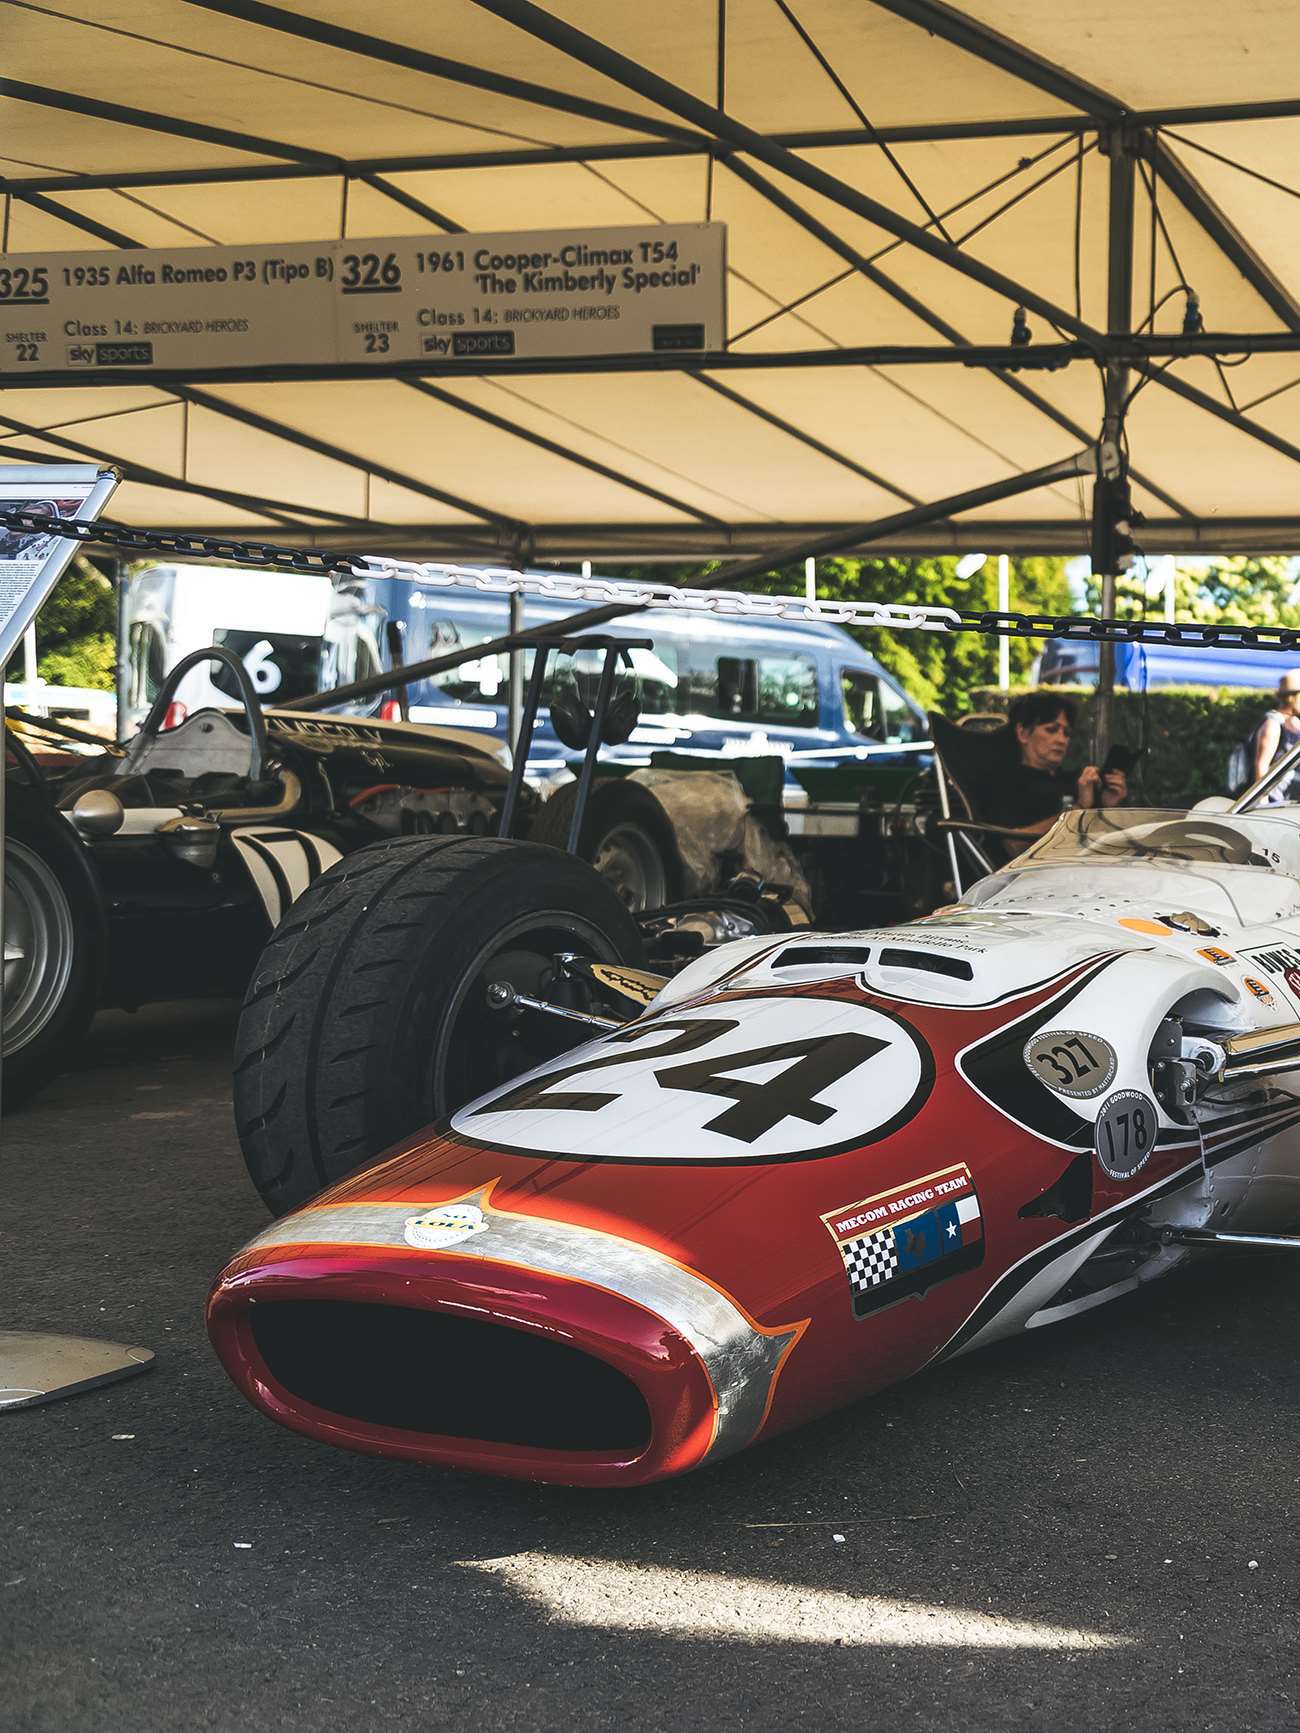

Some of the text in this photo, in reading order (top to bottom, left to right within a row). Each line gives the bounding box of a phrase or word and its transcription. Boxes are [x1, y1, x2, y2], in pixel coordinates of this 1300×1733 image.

[62, 256, 334, 287] 1935 Alfa Romeo P3 (Tipo B)
[341, 252, 401, 287] 326
[415, 241, 679, 275] 1961 Cooper-Climax T54
[0, 267, 48, 299] 325
[474, 263, 702, 296] 'The Kimberly Special'
[63, 318, 249, 337] Class 14: BRICKYARD HEROES
[352, 321, 400, 334] SHELTER
[416, 304, 621, 327] Class 14: BRICKYARD HEROES
[5, 331, 48, 344] SHELTER
[364, 333, 390, 354] 23
[423, 332, 511, 355] sky sports
[16, 344, 40, 362] 22
[69, 344, 151, 364] sky sports
[1036, 1037, 1100, 1085] 327
[465, 1018, 894, 1145] 24
[1110, 1090, 1143, 1104] GOODWOOD
[1104, 1108, 1148, 1162] 178
[1109, 1151, 1151, 1179] FESTIVAL OF SPEED
[835, 1174, 968, 1234] MECOM RACING TEAM
